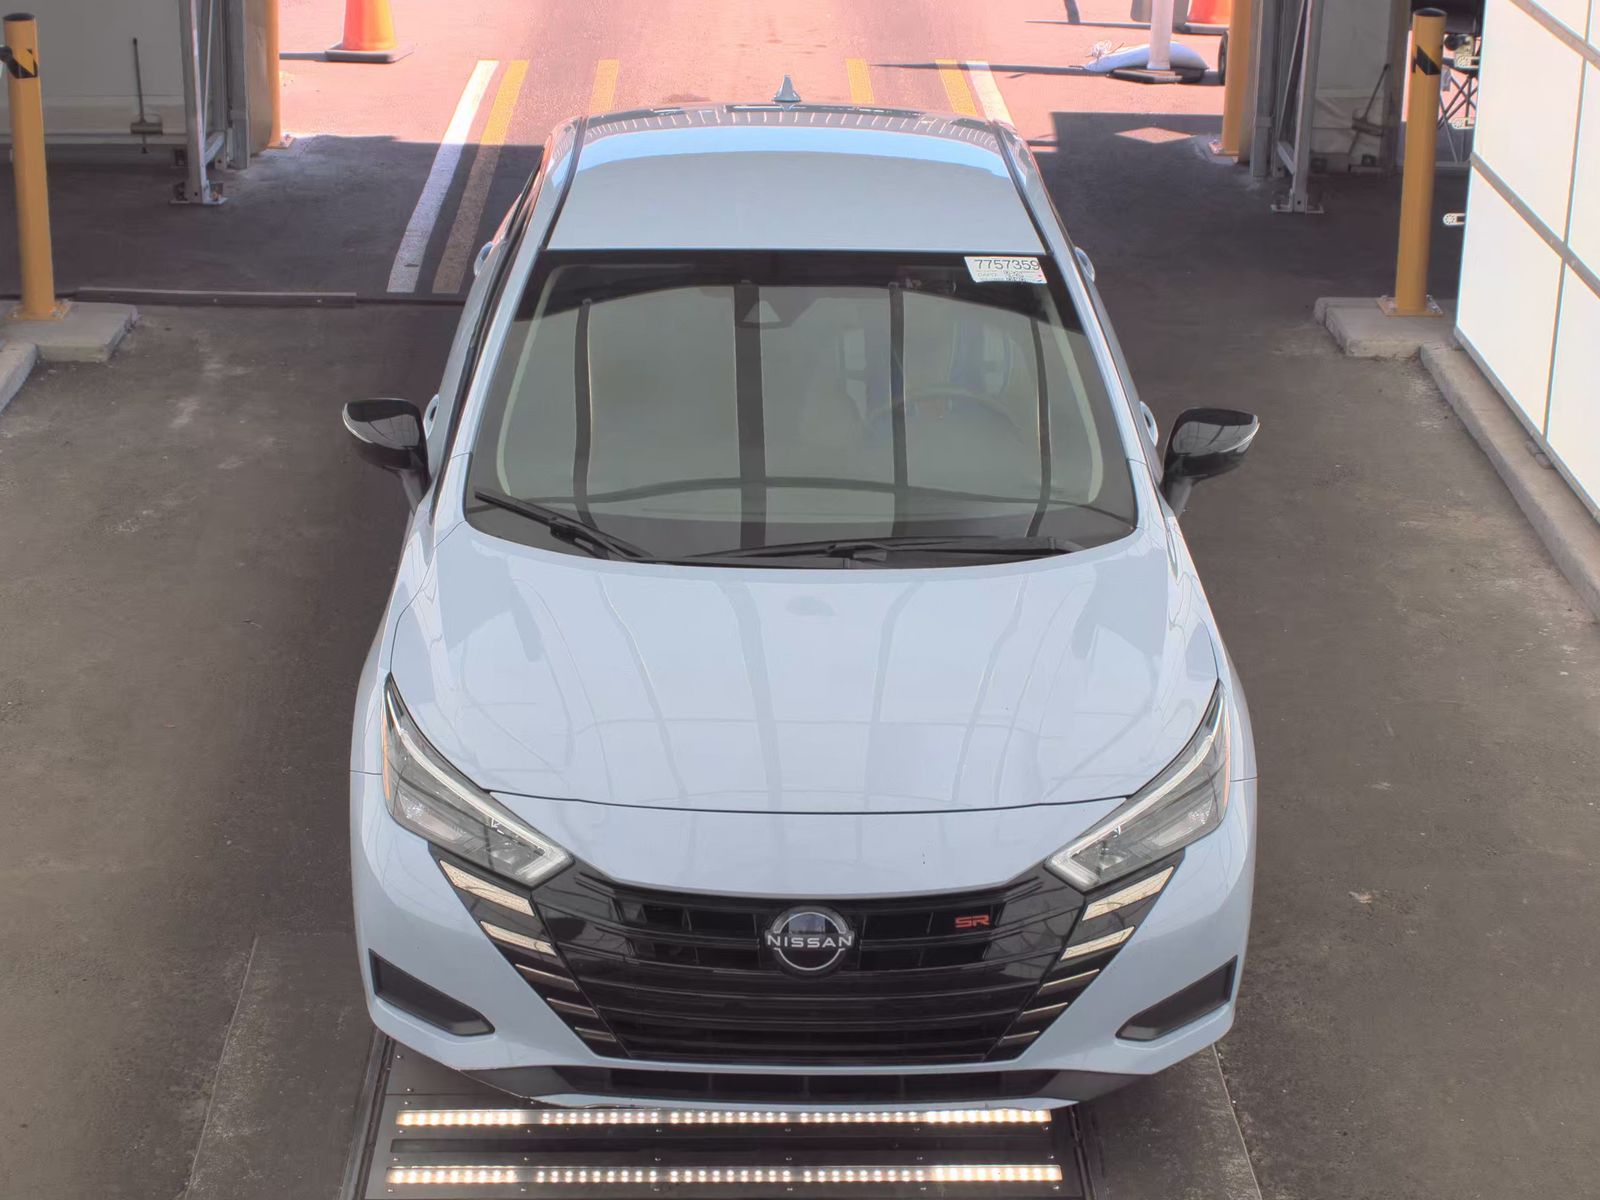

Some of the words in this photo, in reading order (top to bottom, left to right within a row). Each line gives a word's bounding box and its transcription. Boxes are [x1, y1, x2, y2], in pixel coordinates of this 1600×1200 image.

[974, 259, 1041, 271] 7757359
[955, 914, 990, 928] SR
[766, 934, 852, 948] NISSAN
